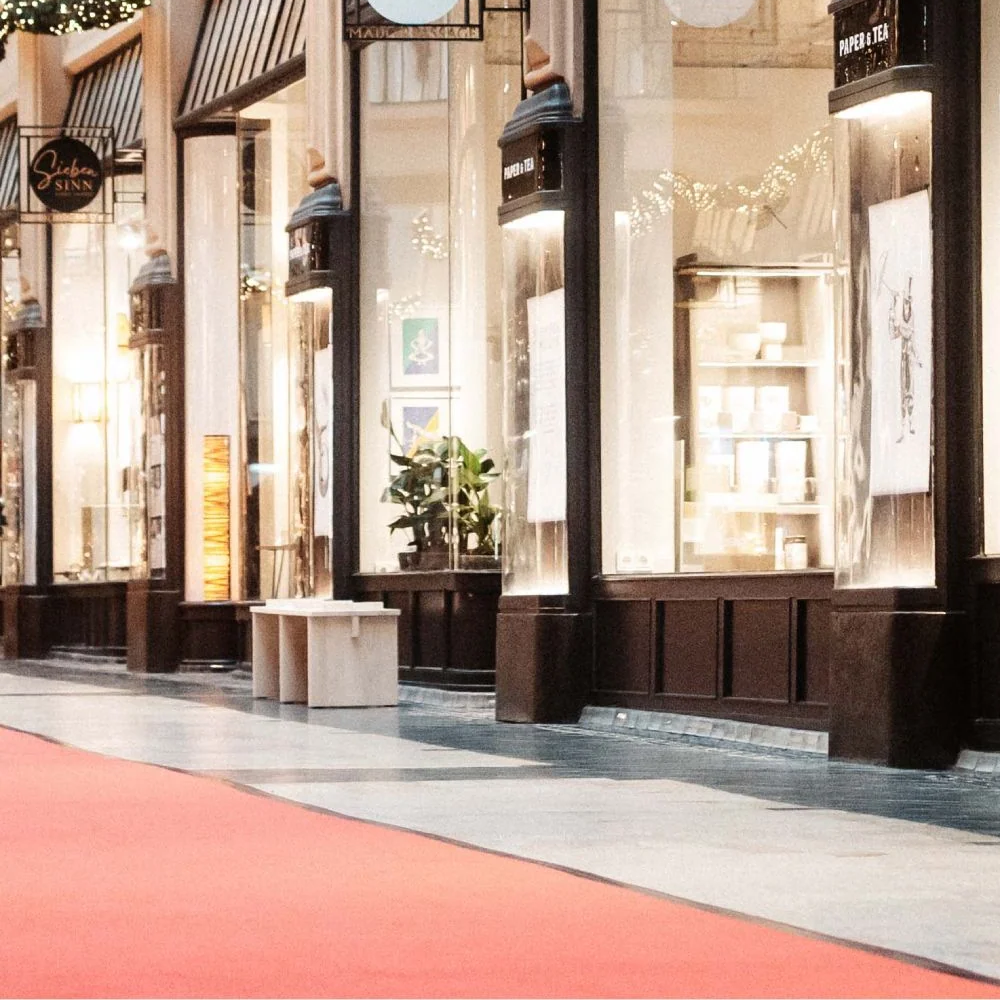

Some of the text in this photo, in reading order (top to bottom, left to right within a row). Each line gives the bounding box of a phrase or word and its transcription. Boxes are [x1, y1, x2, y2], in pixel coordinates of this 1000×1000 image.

[839, 22, 889, 57] PAPER & TEA
[33, 149, 97, 190] Sieben
[504, 162, 520, 180] PAPER
[524, 157, 535, 172] TEA
[55, 179, 93, 193] SINN
